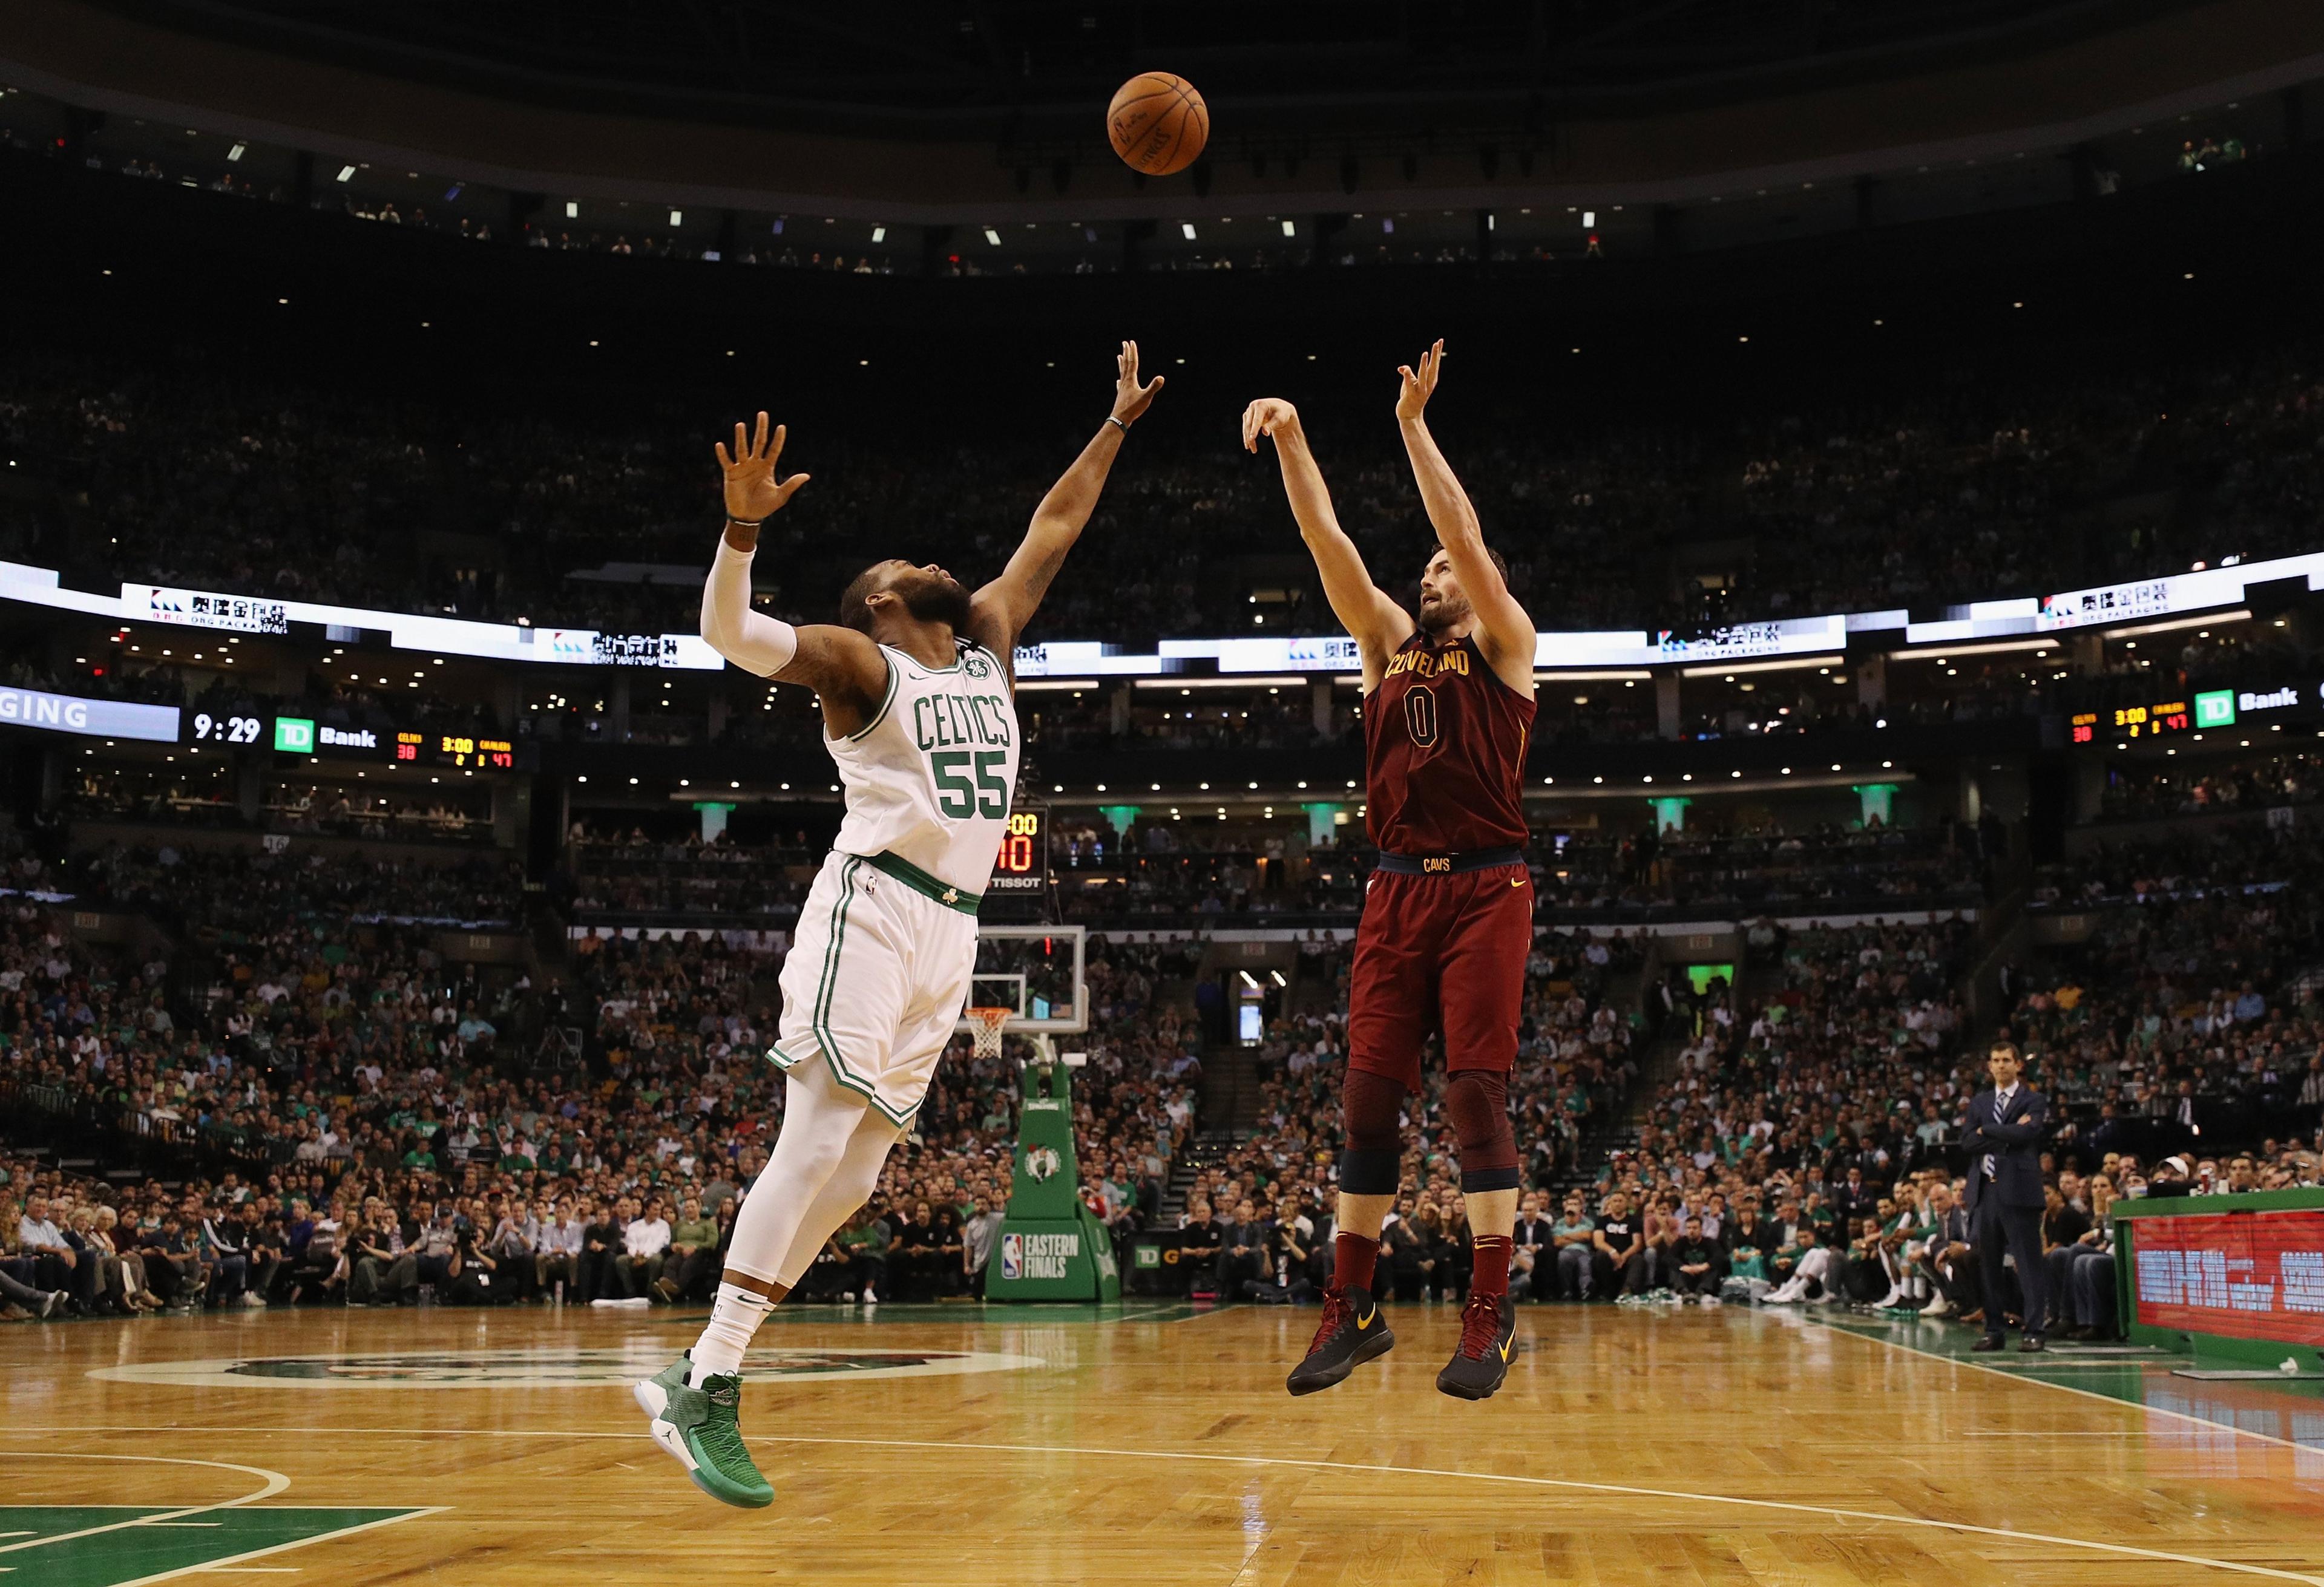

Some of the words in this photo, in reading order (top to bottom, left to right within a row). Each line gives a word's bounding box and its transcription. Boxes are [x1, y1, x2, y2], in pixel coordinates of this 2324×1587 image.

[1384, 649, 1469, 679] CLEVELAND
[0, 692, 87, 728] GING
[2201, 696, 2231, 720] TD
[2239, 686, 2299, 712] Bank
[914, 693, 1010, 751] CELTICS
[1403, 684, 1437, 748] 0
[2115, 707, 2147, 725] 3:00
[2167, 714, 2188, 730] 47
[194, 714, 261, 743] 9:29
[280, 724, 310, 746] TD
[320, 727, 376, 748] Bank
[442, 736, 474, 754] 3:00
[492, 753, 513, 768] 47
[930, 751, 1008, 820] 55
[1423, 857, 1450, 872] CAVS
[991, 878, 1042, 888] TISSOT
[1025, 1234, 1078, 1256] EASTERN
[1025, 1256, 1066, 1278] FINALS
[1138, 1249, 1158, 1265] TD
